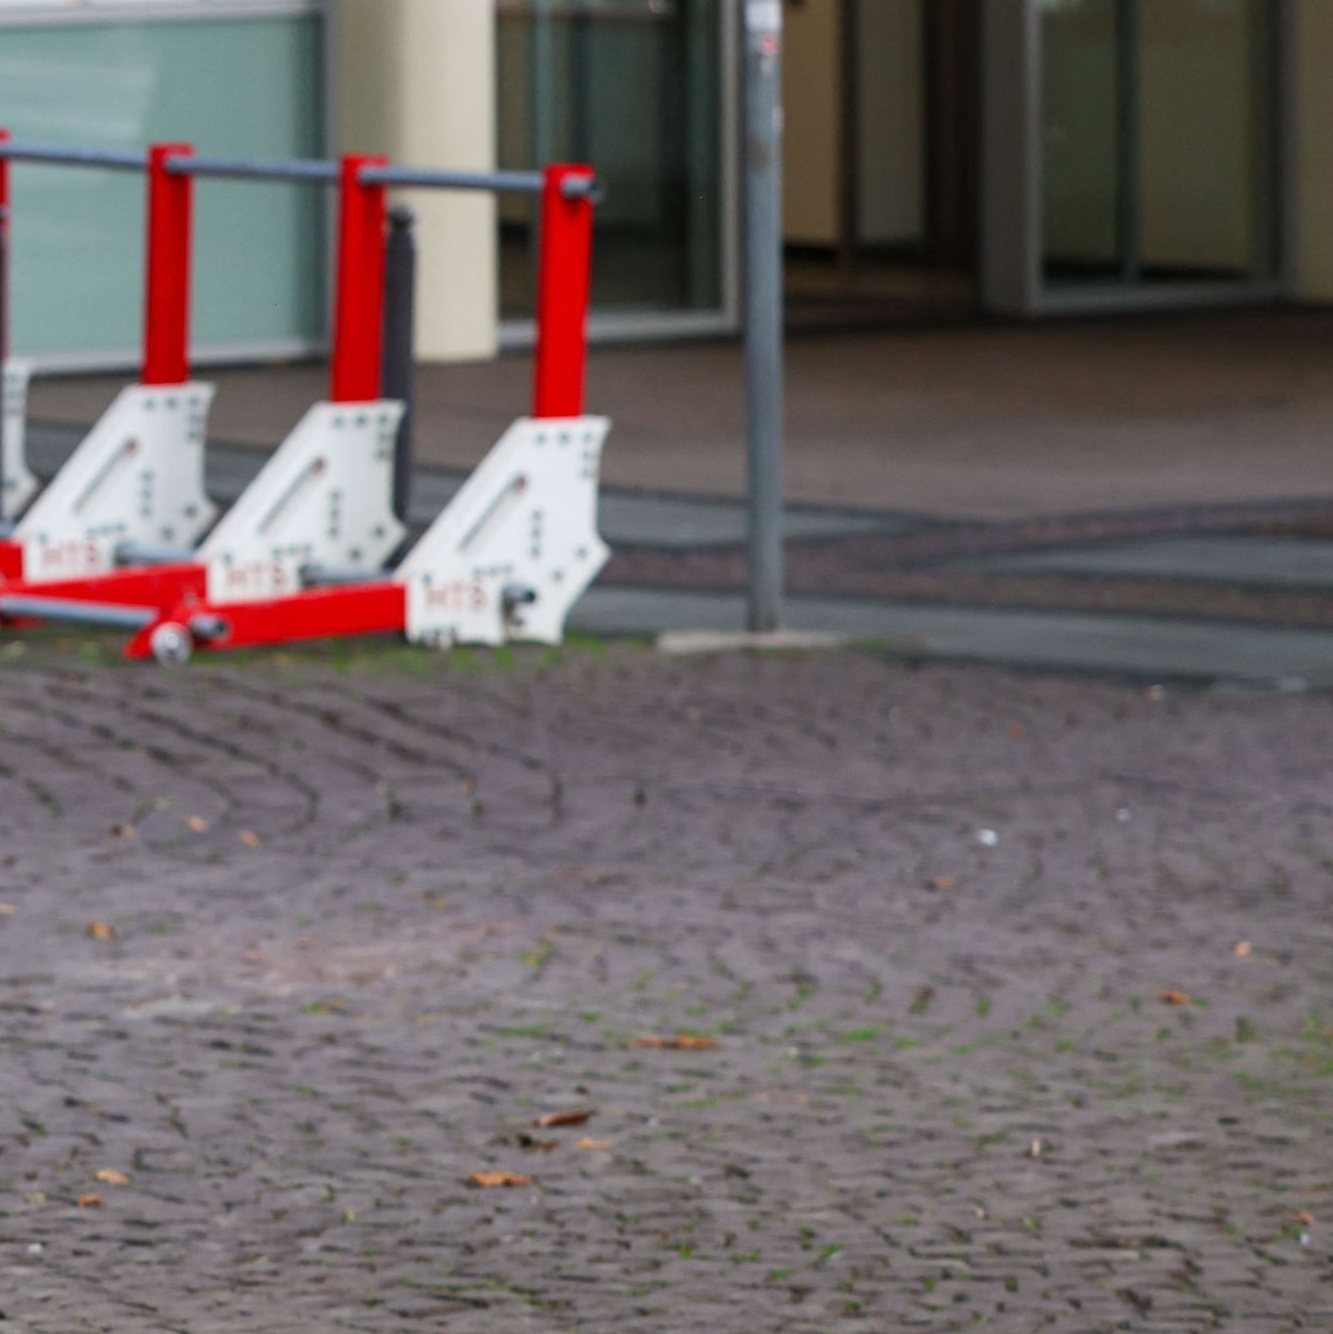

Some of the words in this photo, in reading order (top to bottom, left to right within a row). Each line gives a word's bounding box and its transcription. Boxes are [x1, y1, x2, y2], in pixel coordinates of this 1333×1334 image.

[41, 537, 101, 567] HTS
[225, 561, 286, 589] HTS
[425, 579, 486, 609] HTS
